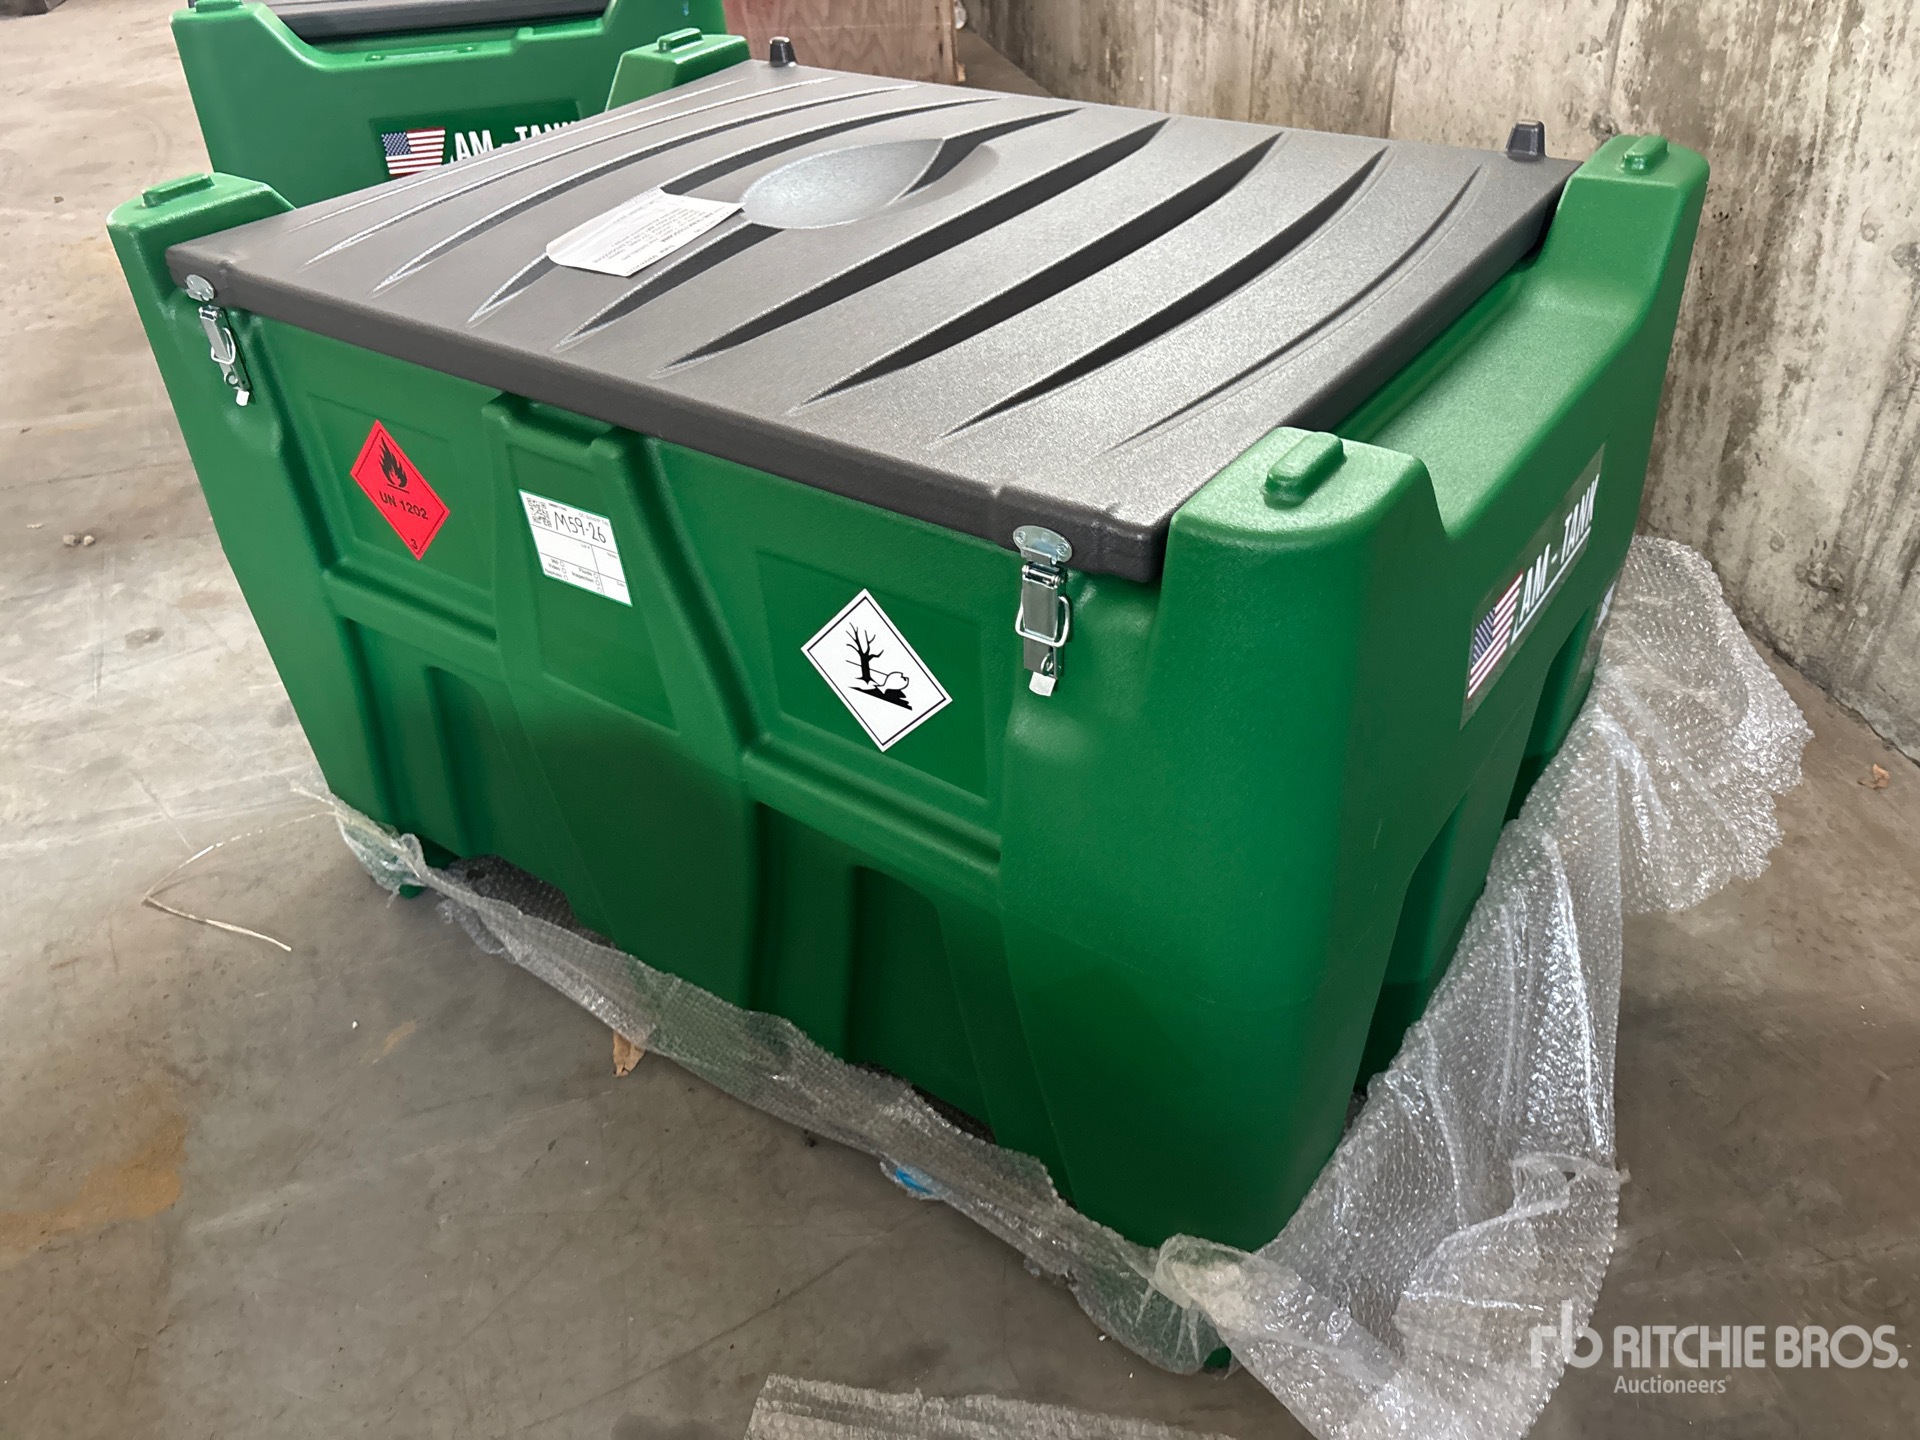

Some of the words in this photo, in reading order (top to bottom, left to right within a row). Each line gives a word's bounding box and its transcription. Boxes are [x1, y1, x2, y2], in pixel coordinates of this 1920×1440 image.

[454, 130, 494, 162] AM
[379, 491, 398, 508] UN
[399, 500, 428, 520] 1202
[554, 511, 607, 544] M59-26
[410, 538, 418, 550] 3
[1518, 543, 1551, 624] AM
[1560, 473, 1600, 565] TANK
